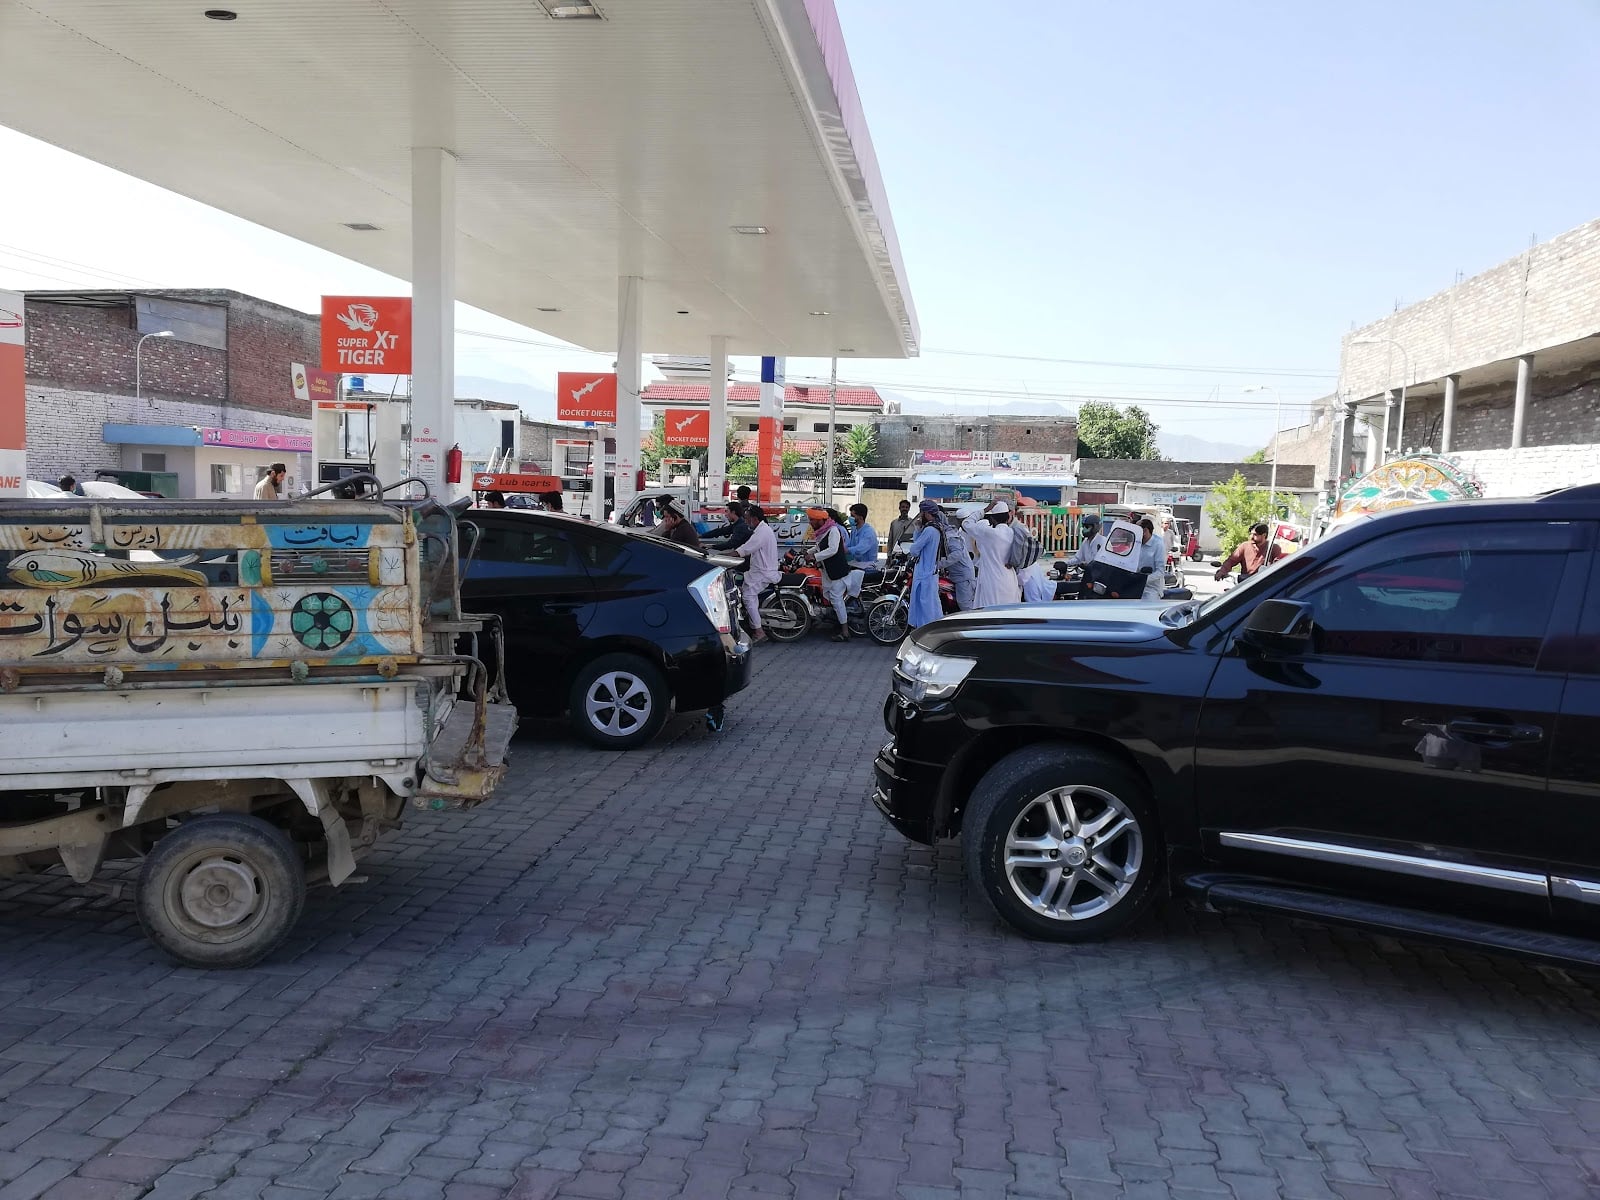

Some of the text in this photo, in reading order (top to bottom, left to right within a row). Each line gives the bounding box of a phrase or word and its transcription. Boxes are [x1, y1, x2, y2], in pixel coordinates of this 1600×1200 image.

[337, 330, 399, 349] SUPER XT
[337, 349, 384, 365] TIGER
[560, 408, 615, 418] ROCKET DIESEL
[241, 434, 258, 443] SHOP
[499, 477, 518, 486] Lub
